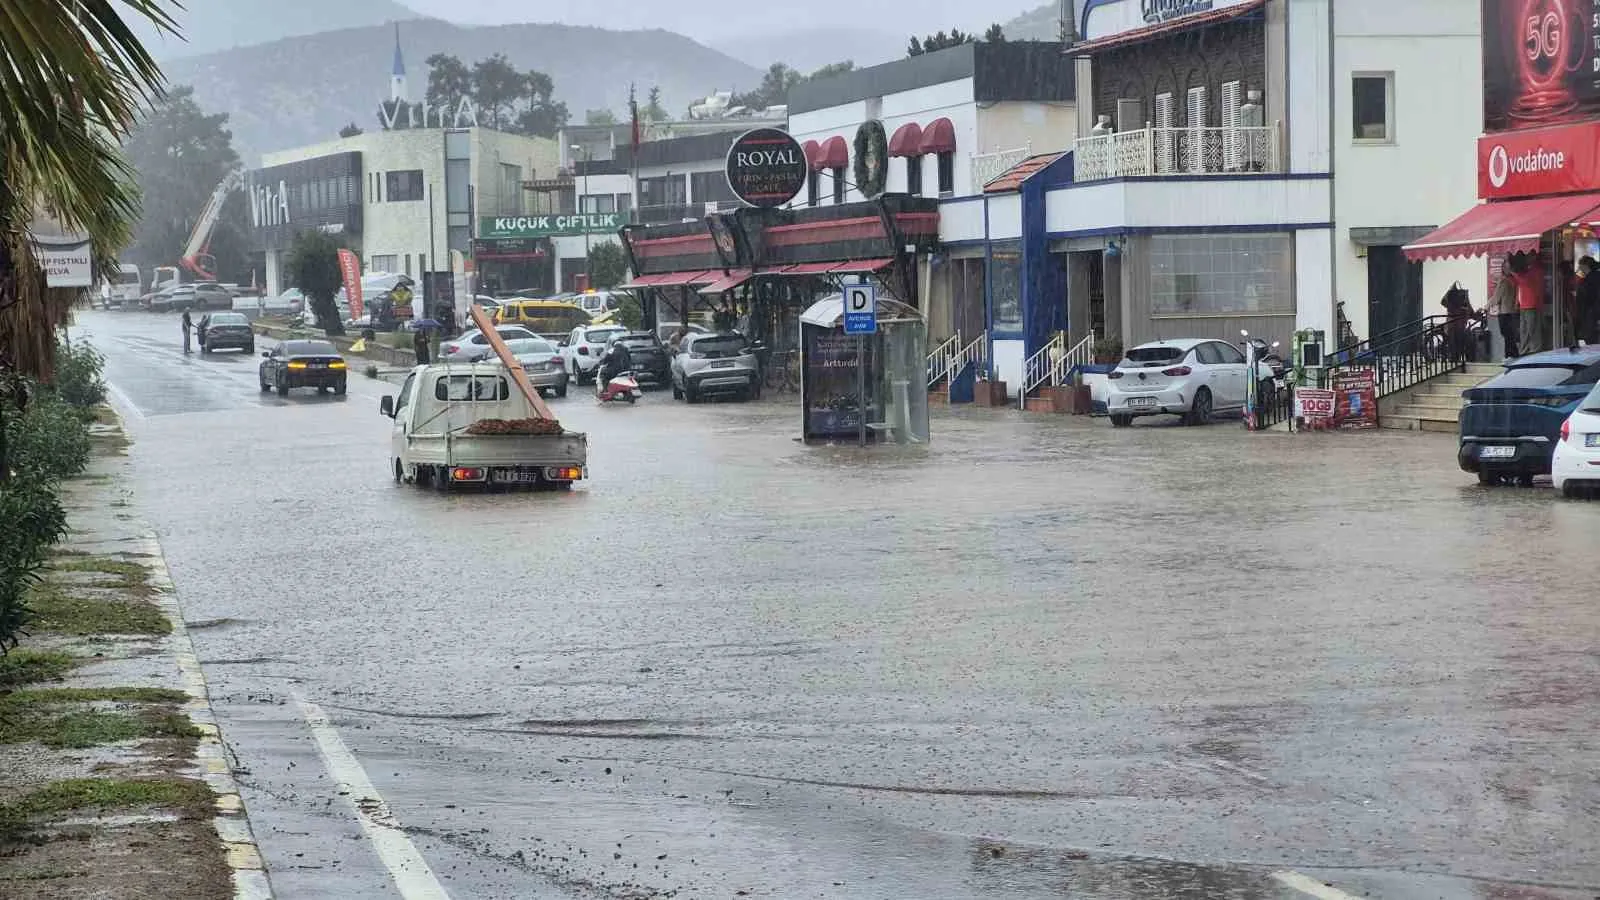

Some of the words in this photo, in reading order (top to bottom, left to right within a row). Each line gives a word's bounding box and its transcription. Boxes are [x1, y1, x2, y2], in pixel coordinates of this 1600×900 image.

[1527, 12, 1560, 60] 5G
[737, 150, 798, 167] ROYAL
[1509, 149, 1564, 173] vodafone
[250, 179, 290, 227] VitrA
[556, 213, 617, 231] ÇİFTLİK
[47, 267, 70, 275] ELVA
[852, 290, 867, 310] D
